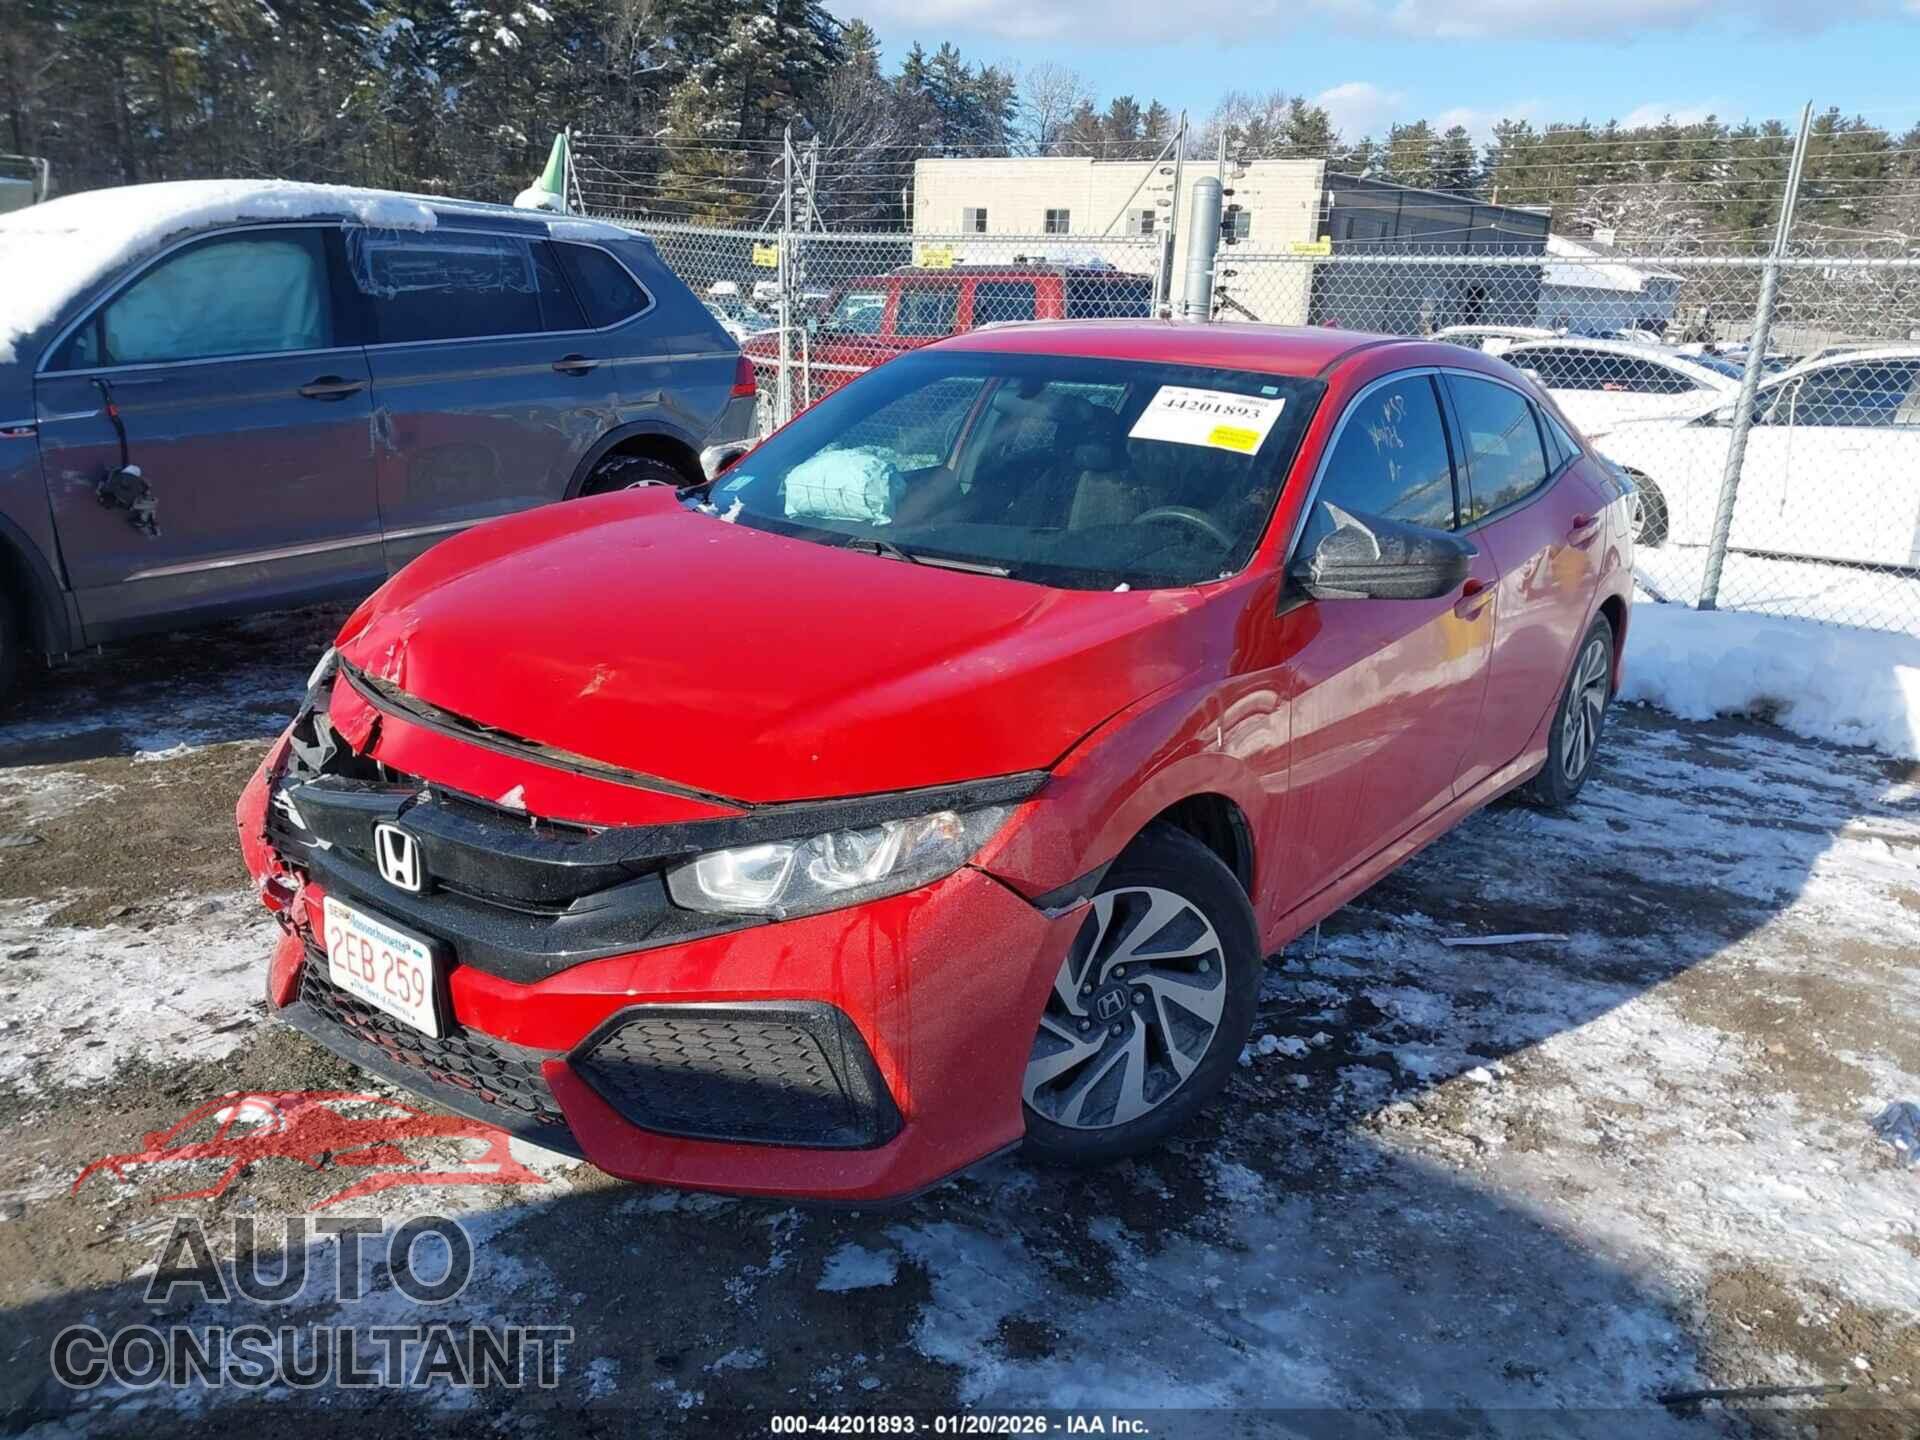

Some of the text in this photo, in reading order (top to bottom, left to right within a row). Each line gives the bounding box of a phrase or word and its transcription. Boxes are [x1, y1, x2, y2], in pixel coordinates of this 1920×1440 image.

[1163, 398, 1261, 419] 44201893
[331, 925, 425, 1008] 2EB 259
